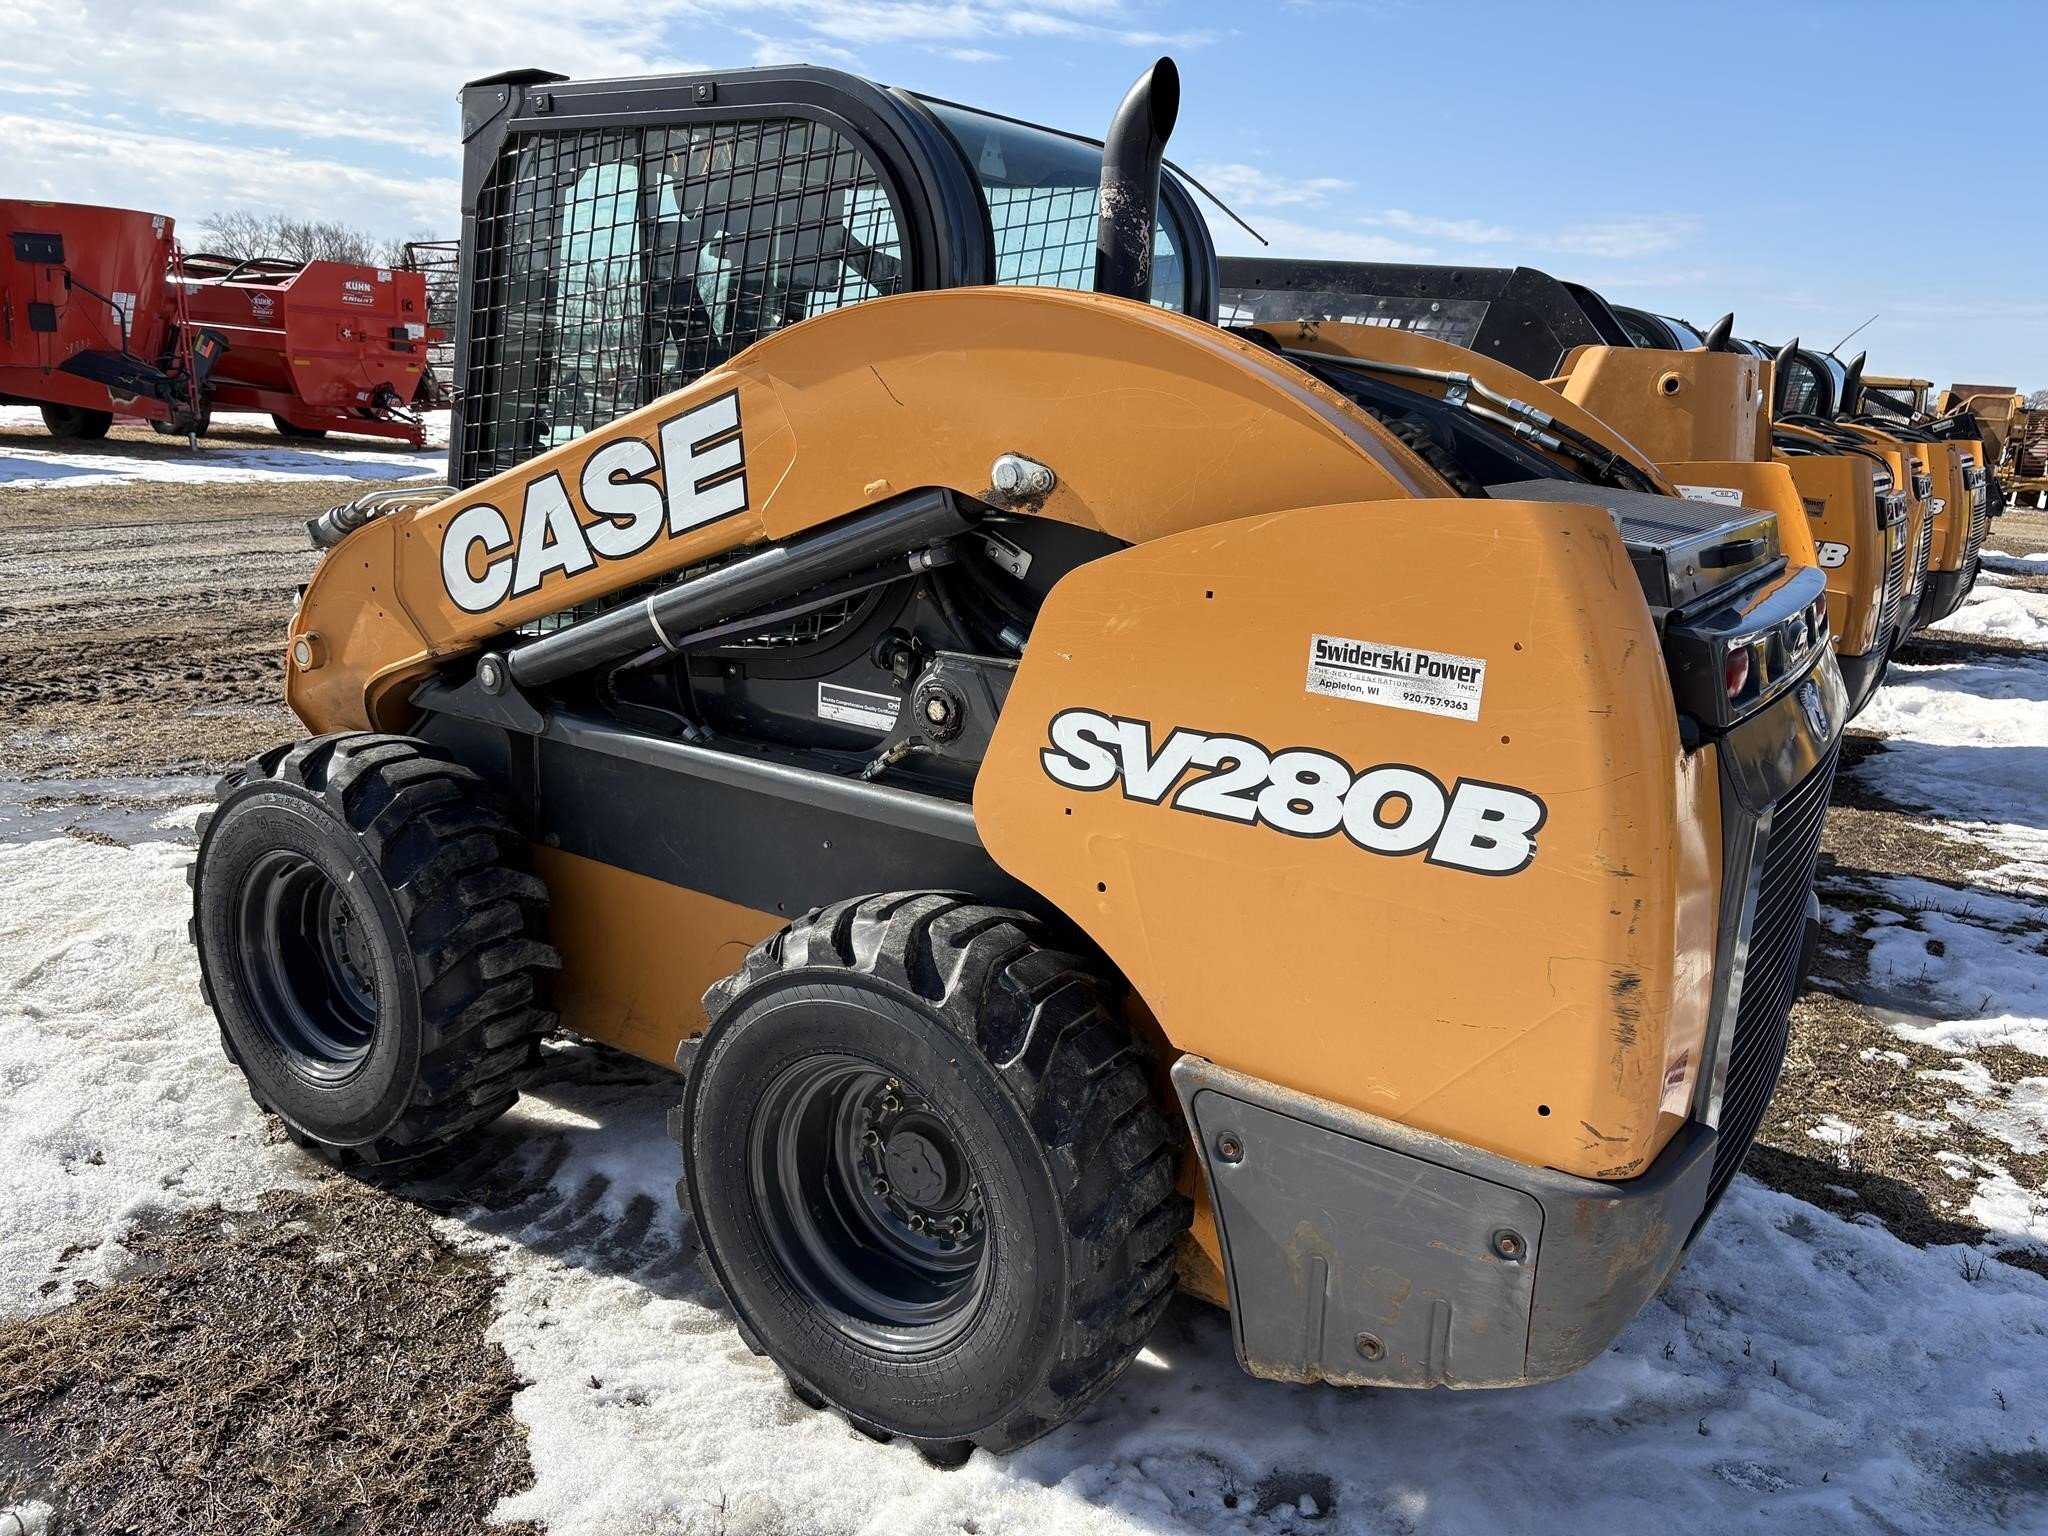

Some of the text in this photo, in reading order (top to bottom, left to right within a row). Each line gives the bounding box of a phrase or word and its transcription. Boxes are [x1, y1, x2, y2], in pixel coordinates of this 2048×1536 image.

[345, 281, 371, 292] KUHN
[342, 295, 375, 304] KNIGHT
[440, 387, 749, 614] CASE
[1315, 639, 1481, 684] Swiderski Power
[1319, 679, 1380, 696] Appleton, WI
[1403, 692, 1468, 711] 920.757.9363
[1040, 707, 1547, 876] SV280B
